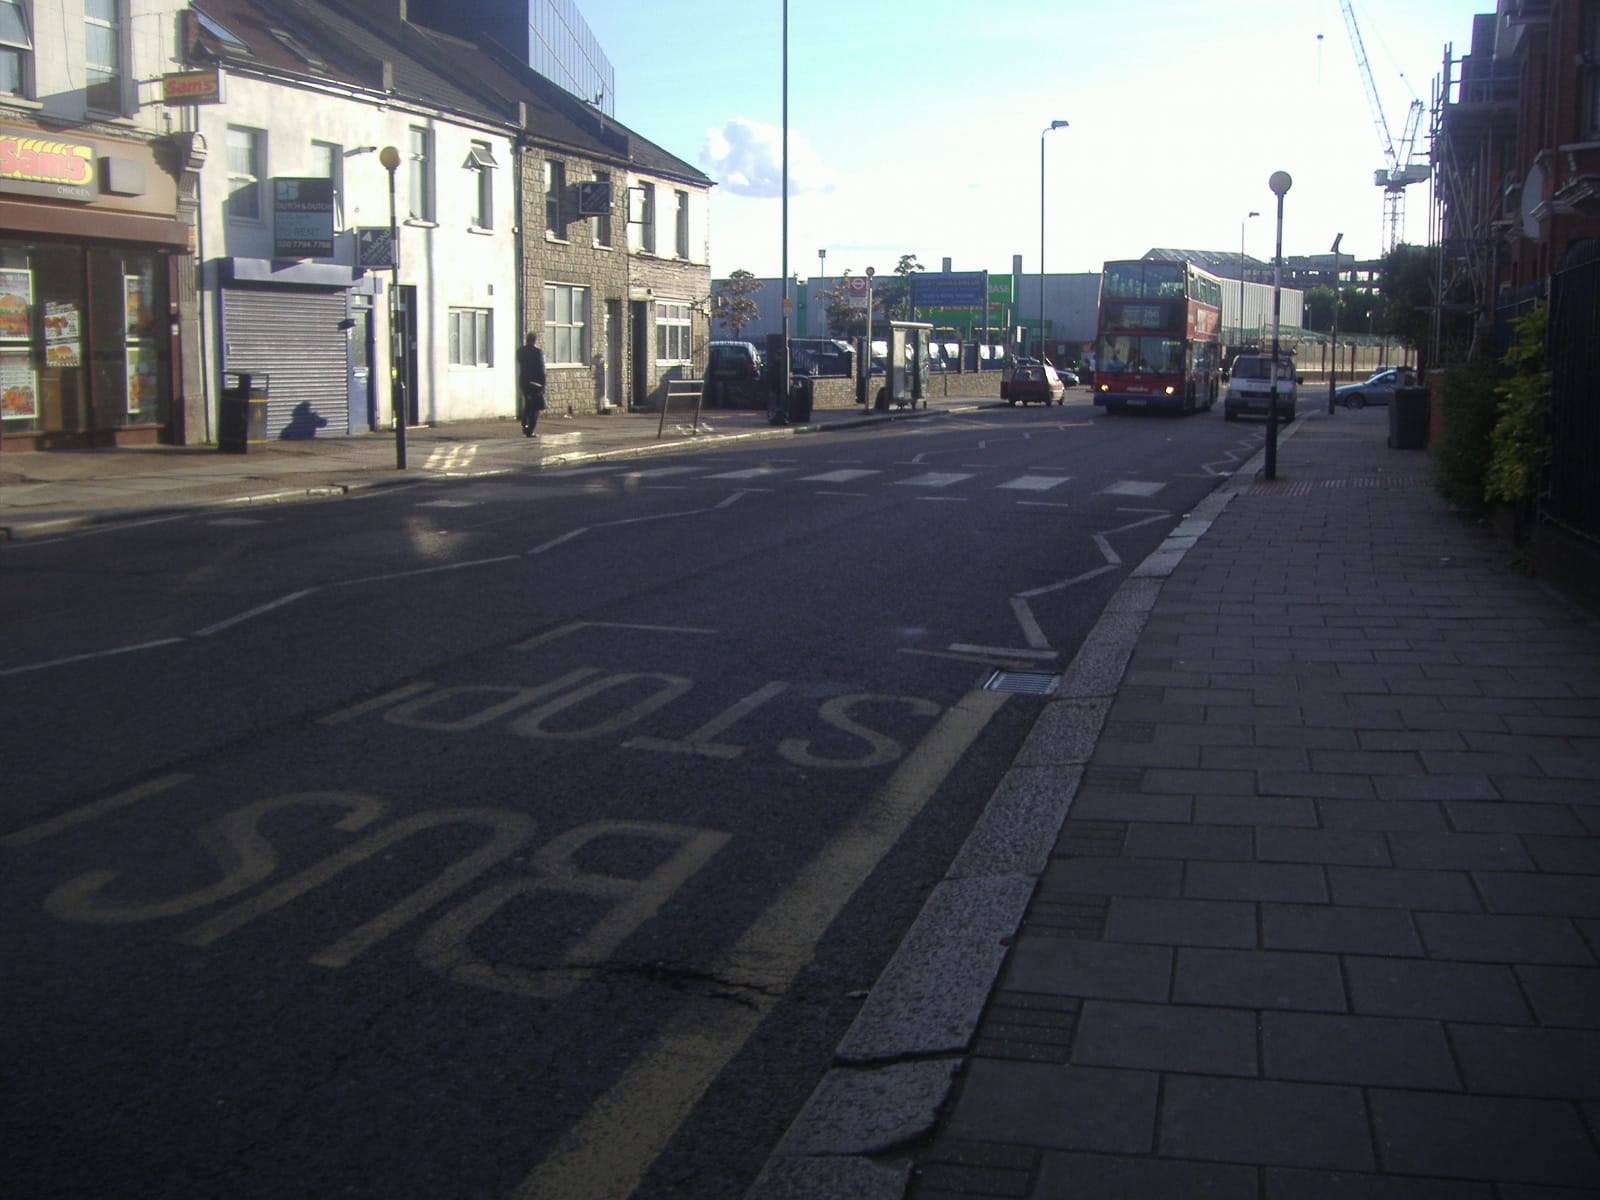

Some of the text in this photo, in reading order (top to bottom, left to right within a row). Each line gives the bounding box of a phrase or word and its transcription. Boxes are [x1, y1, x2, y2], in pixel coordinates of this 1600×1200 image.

[167, 79, 213, 96] Sam's
[0, 139, 87, 181] Sam's
[57, 186, 91, 197] CHICKEN
[383, 666, 943, 770] STOP
[42, 791, 733, 998] BUS
